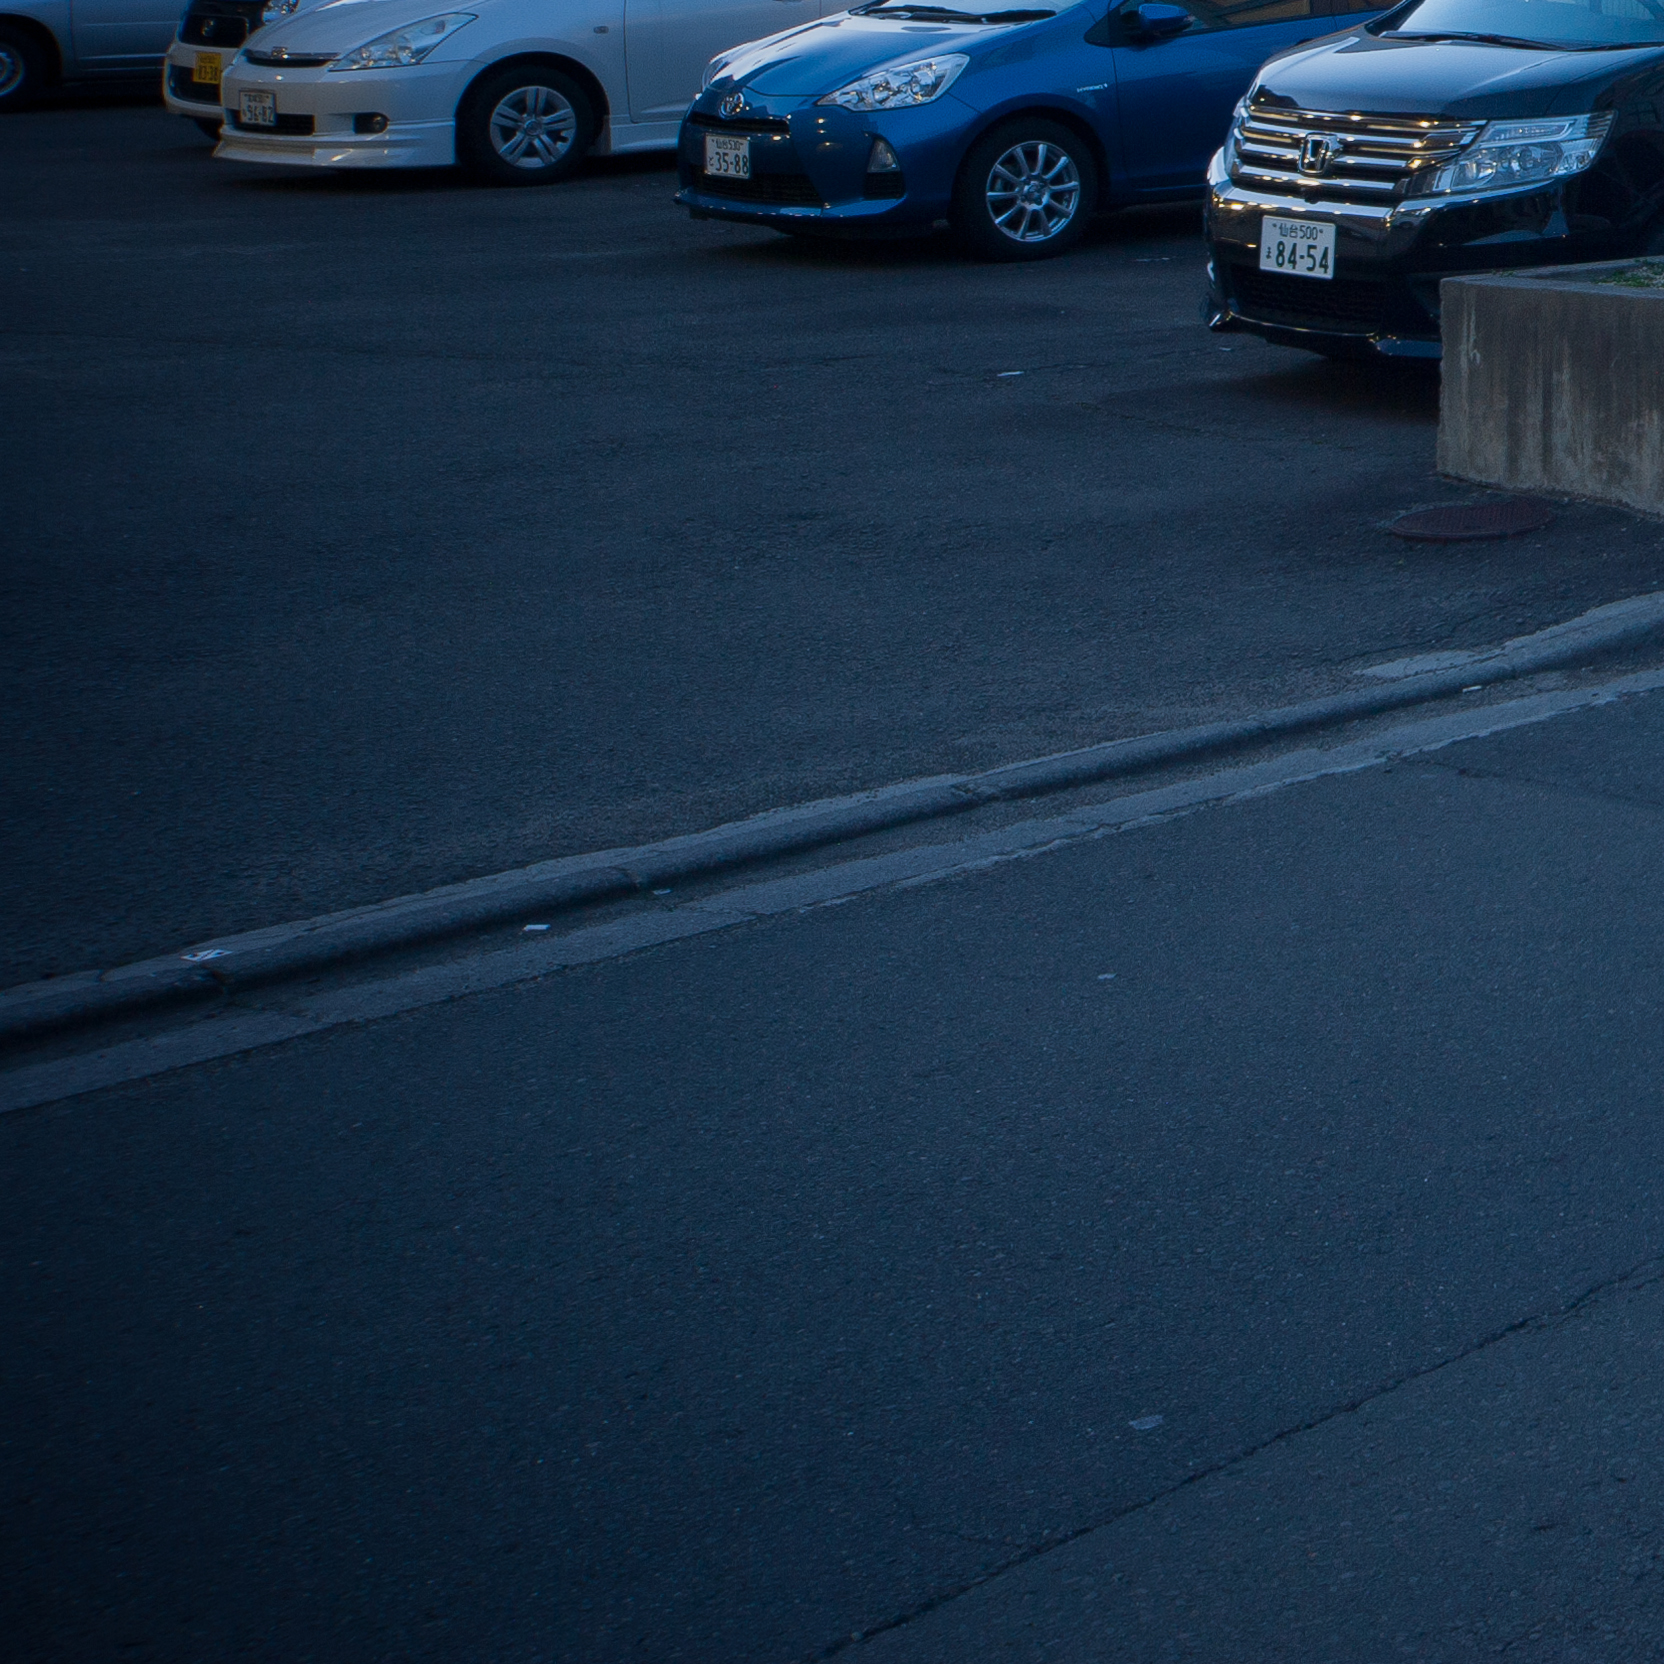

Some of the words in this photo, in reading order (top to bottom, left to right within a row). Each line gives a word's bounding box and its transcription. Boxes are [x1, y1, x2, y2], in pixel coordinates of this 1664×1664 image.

[715, 151, 749, 175] 35-88
[1279, 222, 1319, 241] 仙台500
[1275, 240, 1330, 274] 84-54
